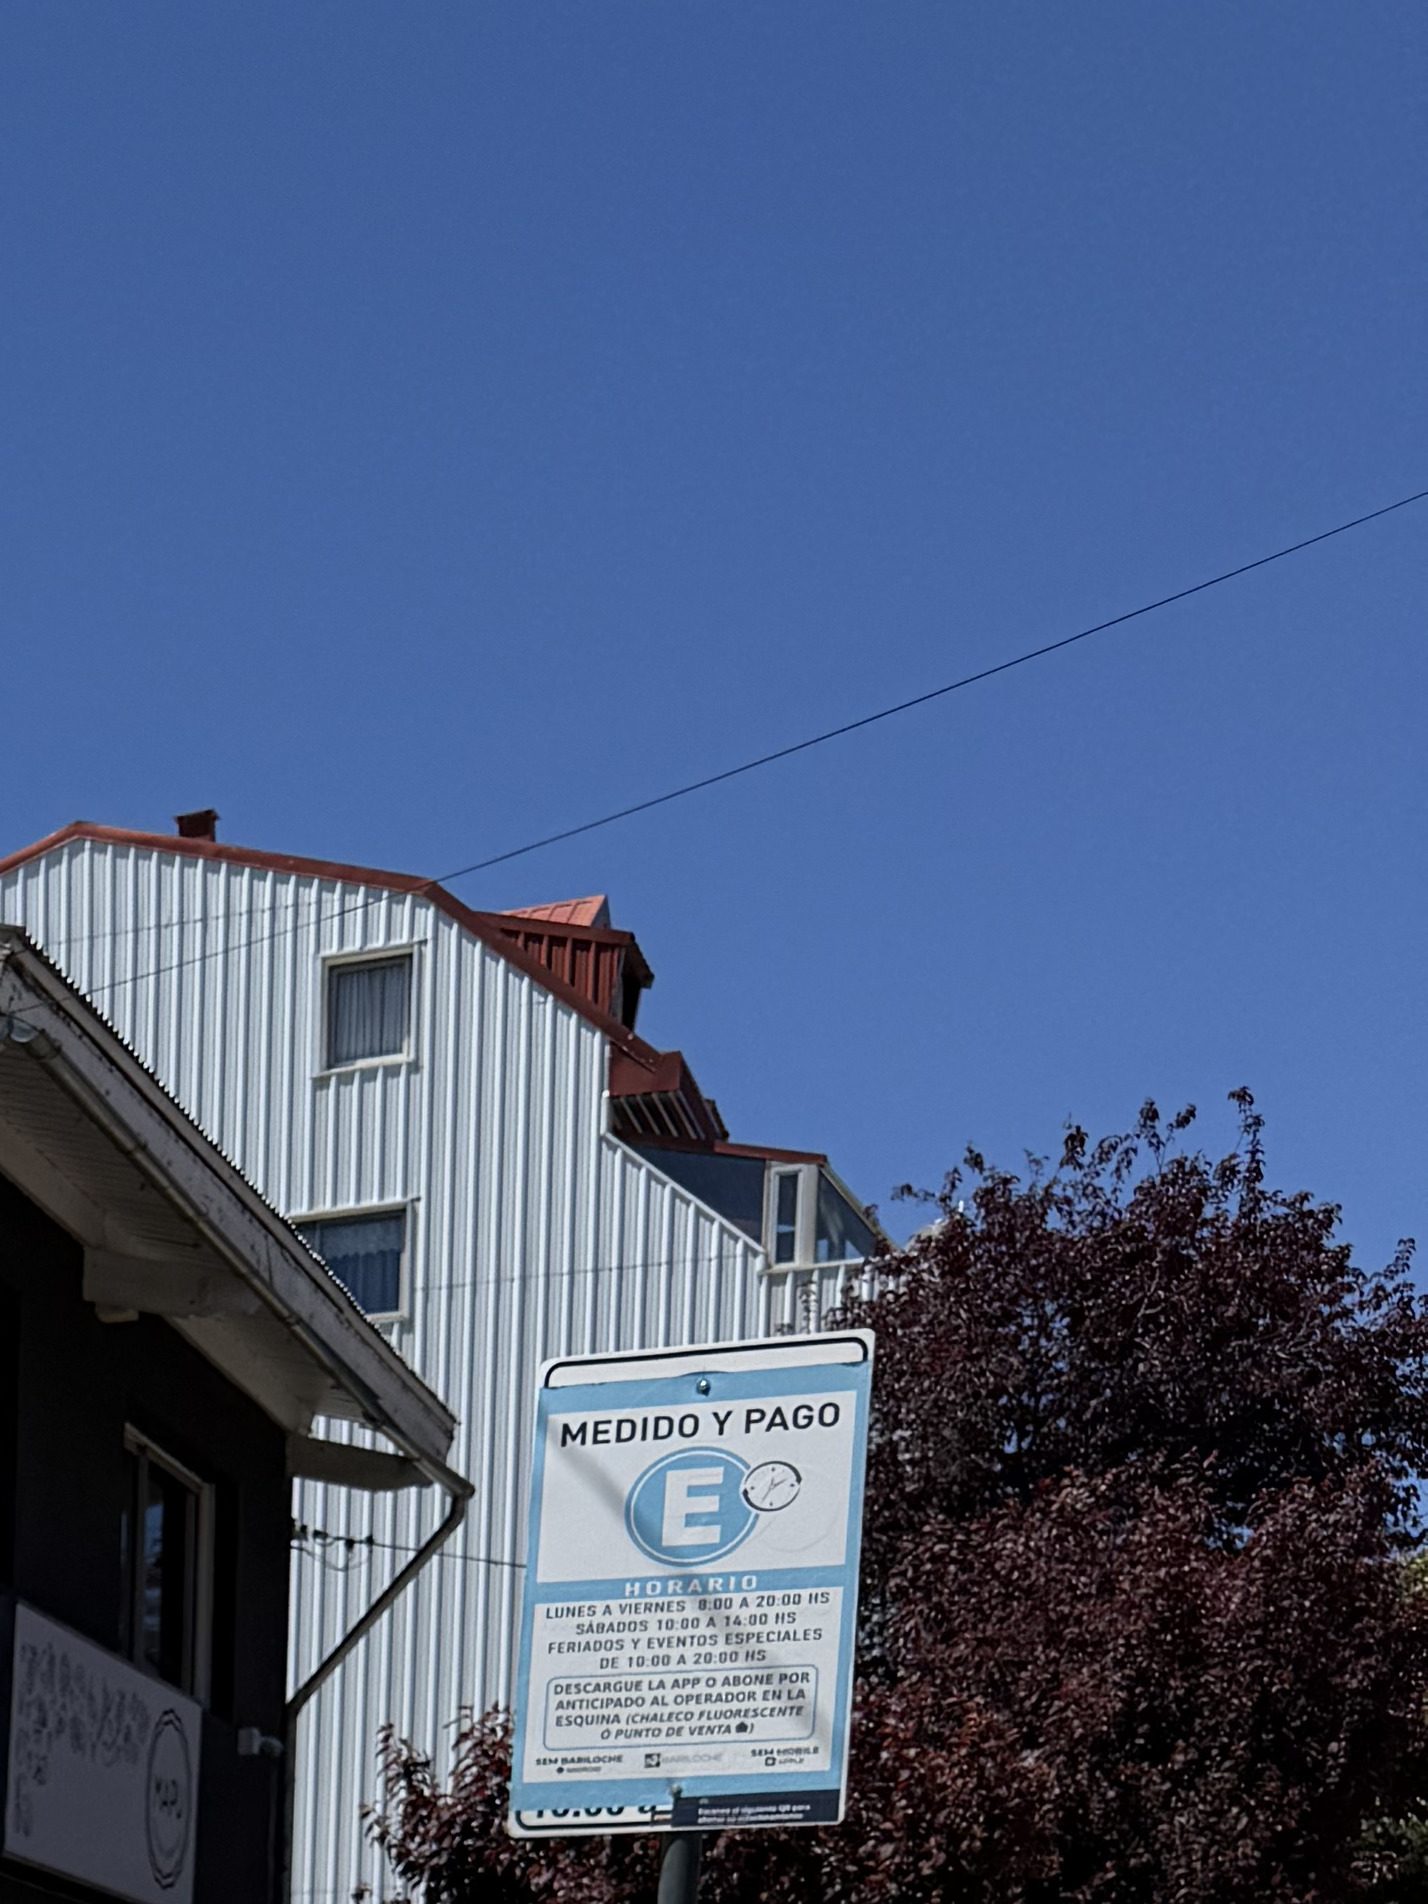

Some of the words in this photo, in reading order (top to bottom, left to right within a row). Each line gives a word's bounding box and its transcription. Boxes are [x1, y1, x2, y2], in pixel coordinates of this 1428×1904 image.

[560, 1413, 700, 1447] MEDIDO
[712, 1410, 733, 1436] Y
[744, 1402, 841, 1434] PAGO
[662, 1466, 724, 1547] E
[624, 1575, 757, 1597] HORARIO
[545, 1604, 597, 1619] LUNES
[602, 1604, 612, 1616] A
[619, 1600, 686, 1615] VIERNES
[698, 1597, 733, 1611] 8:00
[739, 1596, 749, 1609] A
[756, 1593, 802, 1608] 20:00
[808, 1592, 830, 1604] HS
[576, 1619, 649, 1635] SÁBADOS
[657, 1617, 700, 1631] 10:00
[706, 1616, 716, 1628] A
[724, 1613, 768, 1627] 14:00
[775, 1612, 796, 1624] HS
[548, 1638, 624, 1654] FERIADOS
[631, 1638, 641, 1650] Y
[647, 1634, 718, 1649] EVENTOS
[724, 1628, 823, 1645] ESPECIALES
[600, 1657, 619, 1669] DE
[628, 1654, 671, 1668] 10:00
[676, 1654, 686, 1665] A
[693, 1651, 739, 1665] 20:00
[744, 1649, 766, 1662] HS
[554, 1680, 643, 1695] DESCARGUE
[648, 1679, 666, 1691] LA
[671, 1677, 700, 1690] APP
[705, 1676, 716, 1688] O
[721, 1673, 774, 1687] ABONE
[778, 1672, 810, 1685] POR
[555, 1696, 645, 1711] ANTICIPADO
[650, 1695, 669, 1707] AL
[673, 1691, 757, 1706] OPERADOR
[762, 1689, 781, 1701] EN
[787, 1689, 806, 1700] LA
[555, 1713, 621, 1727] ESQUINA
[626, 1710, 694, 1726] (CHALECO
[697, 1706, 804, 1721] FLUORESCENTE
[615, 1727, 662, 1740] PUNTO
[665, 1726, 684, 1738] DE
[688, 1724, 732, 1736] VENTA
[561, 1755, 623, 1765] BARILOCHE
